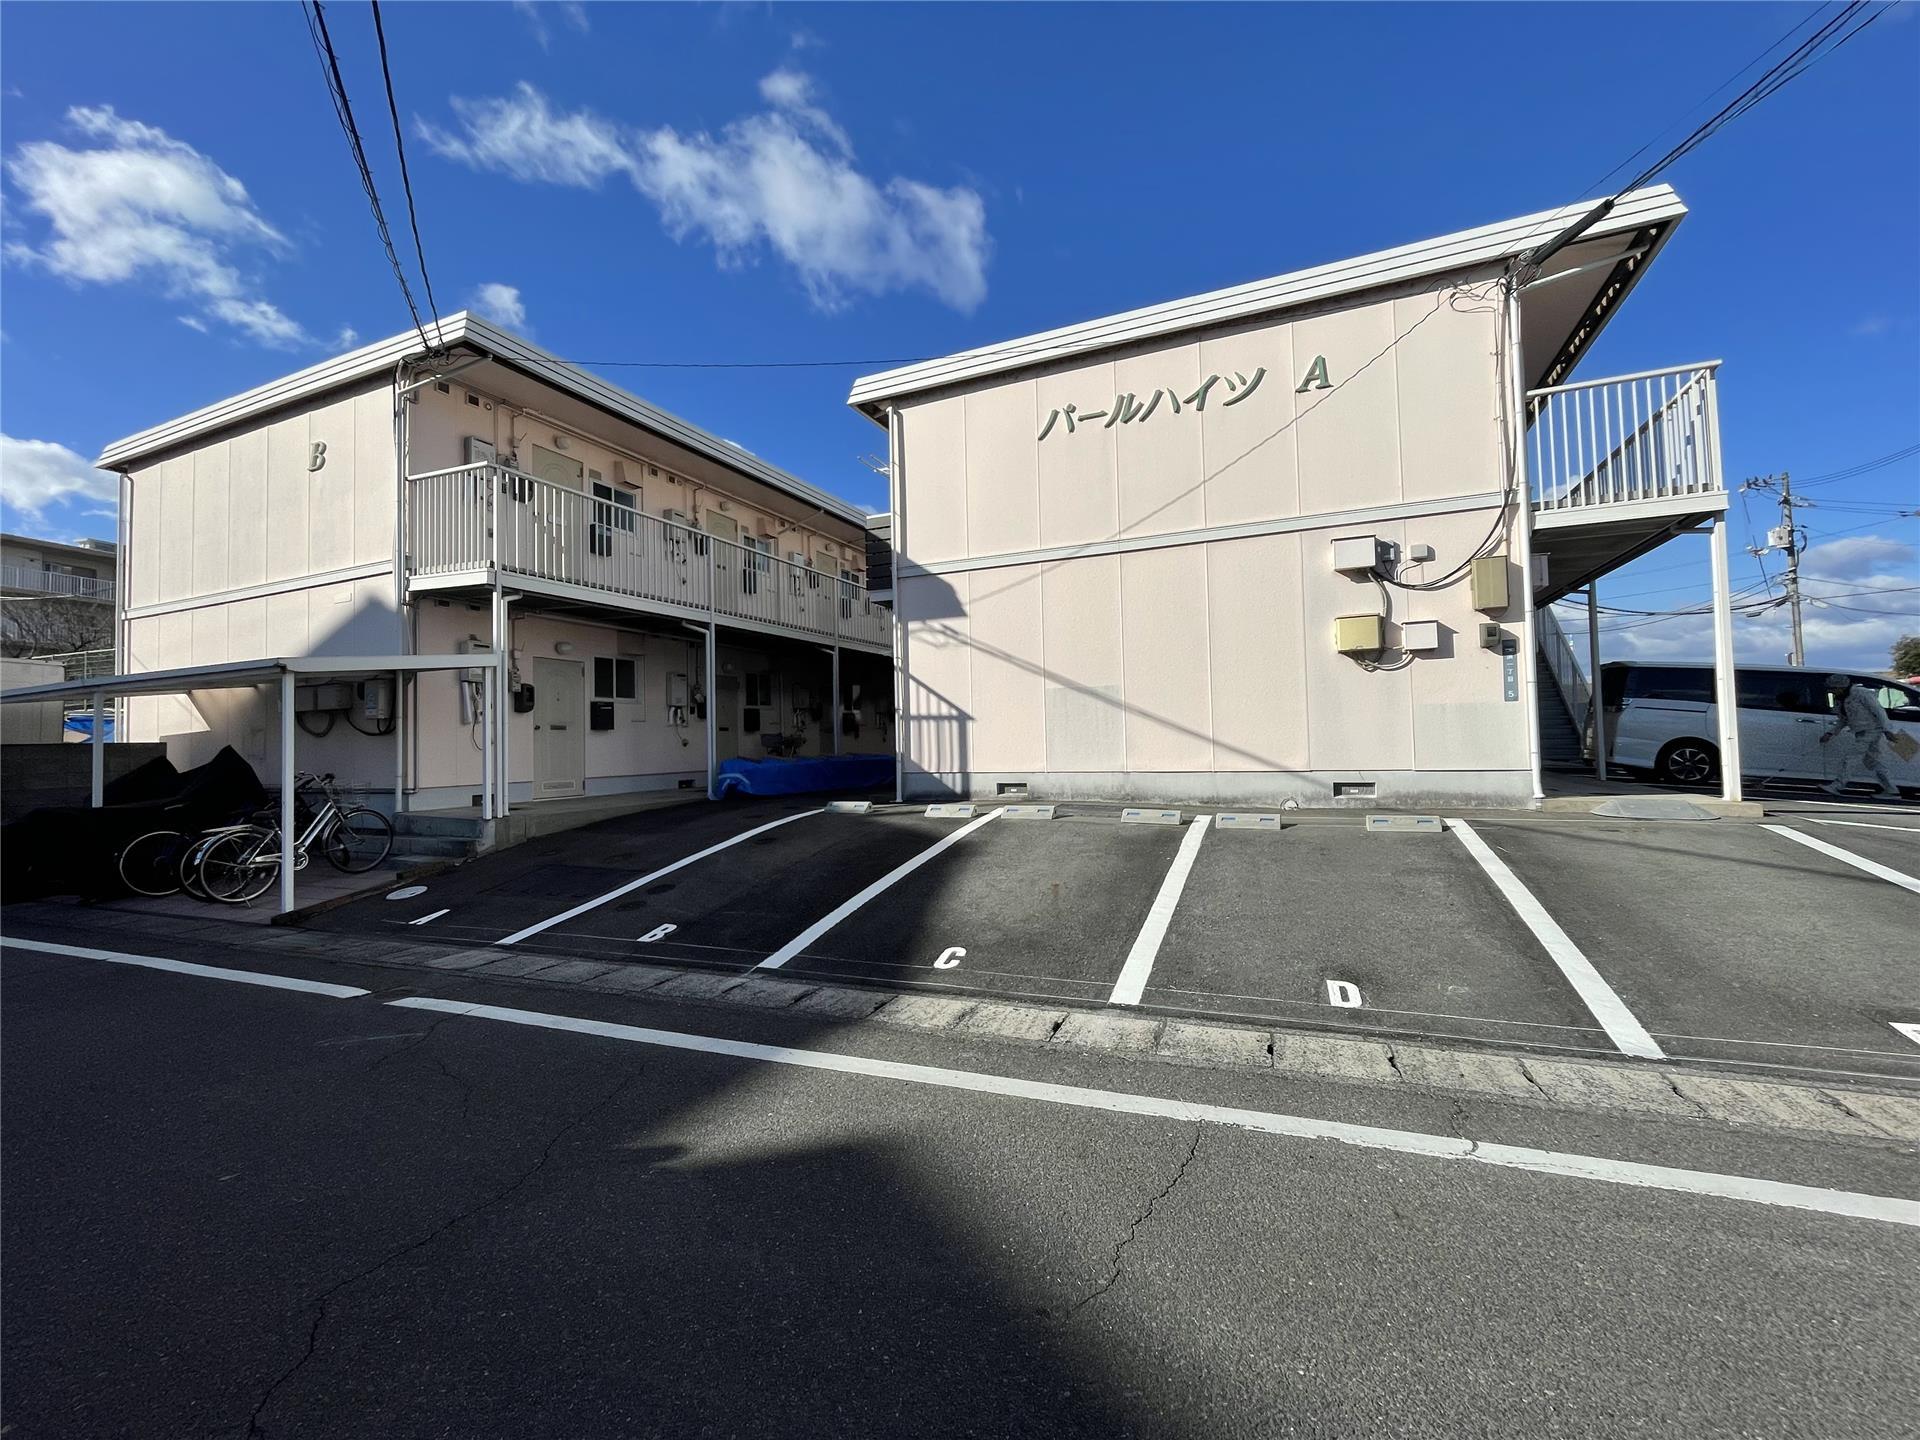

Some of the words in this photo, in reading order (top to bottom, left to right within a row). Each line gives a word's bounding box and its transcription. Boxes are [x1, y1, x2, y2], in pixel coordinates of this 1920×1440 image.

[1037, 367, 1268, 441] パールハイツ
[1295, 354, 1334, 394] A
[307, 441, 327, 472] B
[1508, 690, 1515, 698] 5
[636, 923, 678, 943] B
[933, 946, 967, 970] C
[1325, 979, 1363, 1009] D
